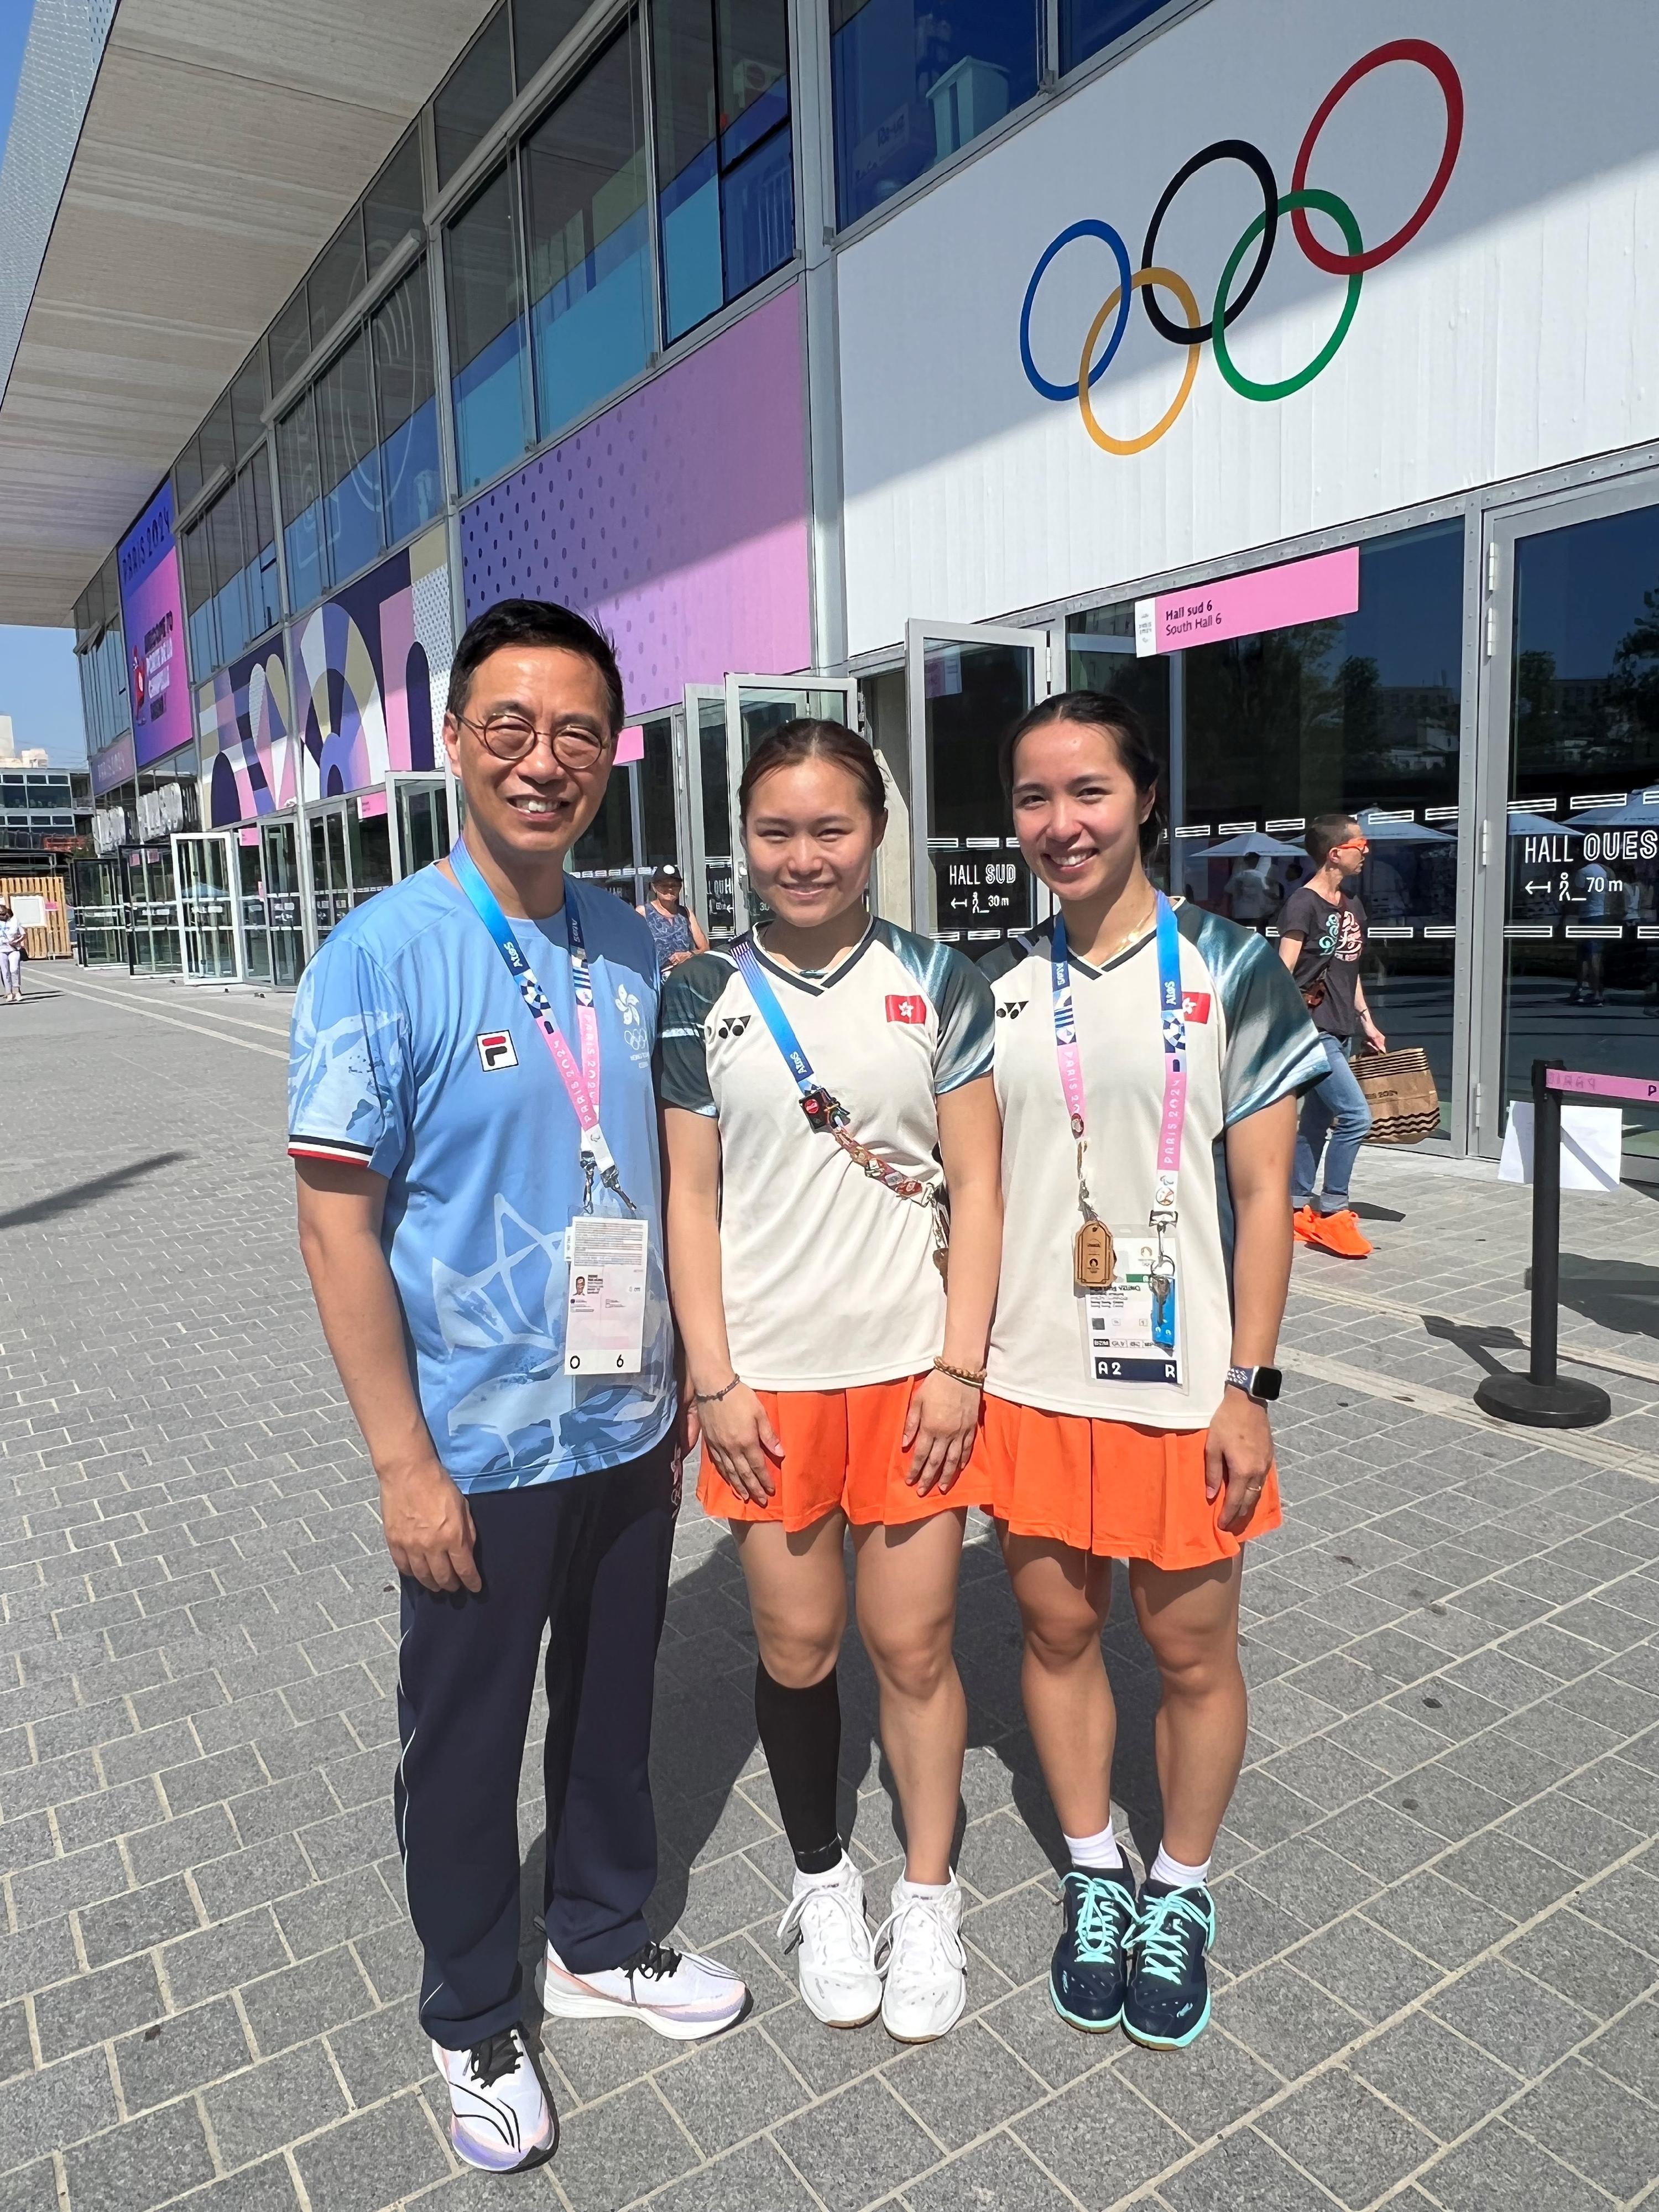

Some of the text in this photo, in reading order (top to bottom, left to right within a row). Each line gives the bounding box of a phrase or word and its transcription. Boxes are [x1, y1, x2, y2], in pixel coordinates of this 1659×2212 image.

[122, 507, 170, 586] PARIS 2024
[1166, 599, 1213, 620] Hall sud 6
[1166, 613, 1222, 636] South Hall 6
[1525, 830, 1658, 864] HALL OUES
[950, 864, 1016, 885] HALL SUD
[1586, 877, 1623, 893] 70 m
[988, 895, 1009, 906] 30 m
[503, 941, 523, 967] Atos
[584, 1014, 596, 1055] PARIS
[554, 1040, 592, 1123] PARIS 2024
[1063, 1051, 1080, 1113] PARIS 20
[1164, 1079, 1181, 1164] PARIS 2024
[617, 1354, 624, 1368] 6
[1165, 1364, 1176, 1378] R
